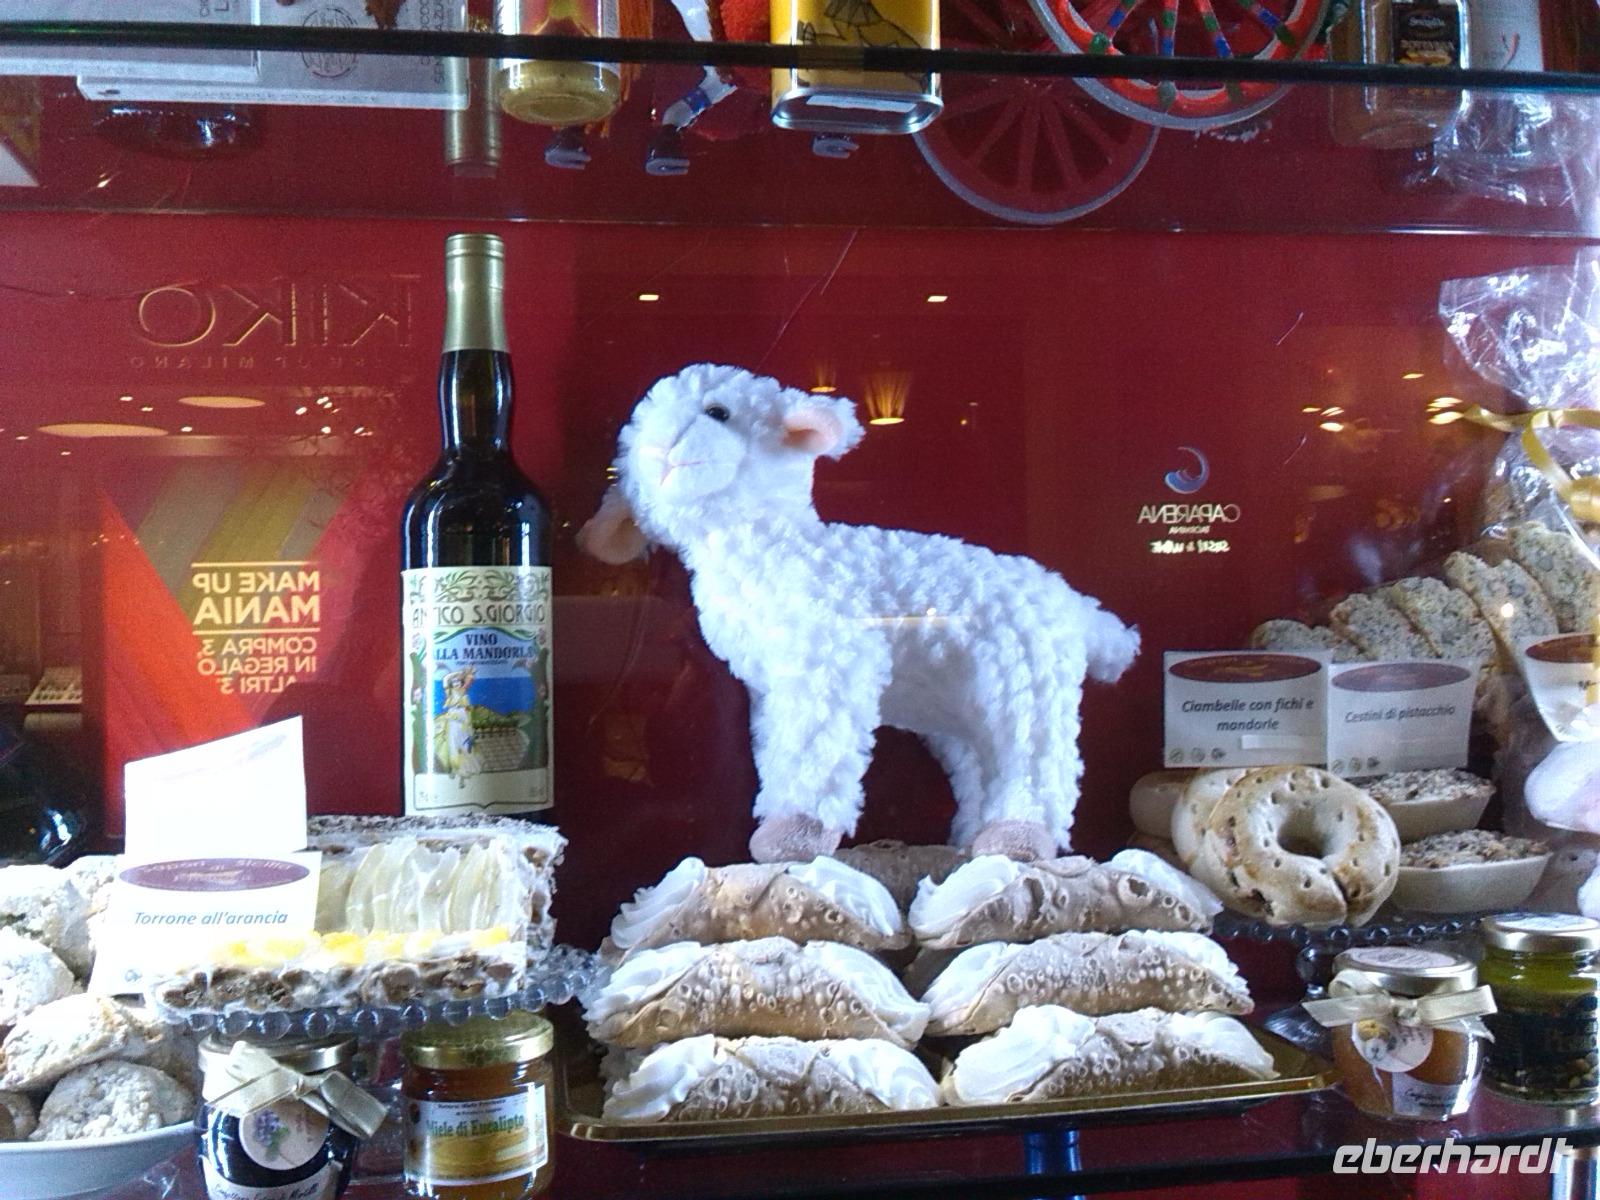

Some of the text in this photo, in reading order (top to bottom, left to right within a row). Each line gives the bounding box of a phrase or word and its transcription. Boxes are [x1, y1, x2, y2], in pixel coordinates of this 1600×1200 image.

[412, 604, 464, 628] AICO
[465, 633, 498, 646] VINO
[433, 645, 535, 660] LLA MANDORLA
[1181, 697, 1314, 714] Ciambelle con fichi e
[1345, 705, 1456, 723] Cestini di pistacchio
[1216, 717, 1279, 732] mandorle
[134, 911, 198, 926] Torrone
[426, 1119, 453, 1137] Miele
[456, 1120, 468, 1137] di
[471, 1114, 524, 1136] Eucalipto
